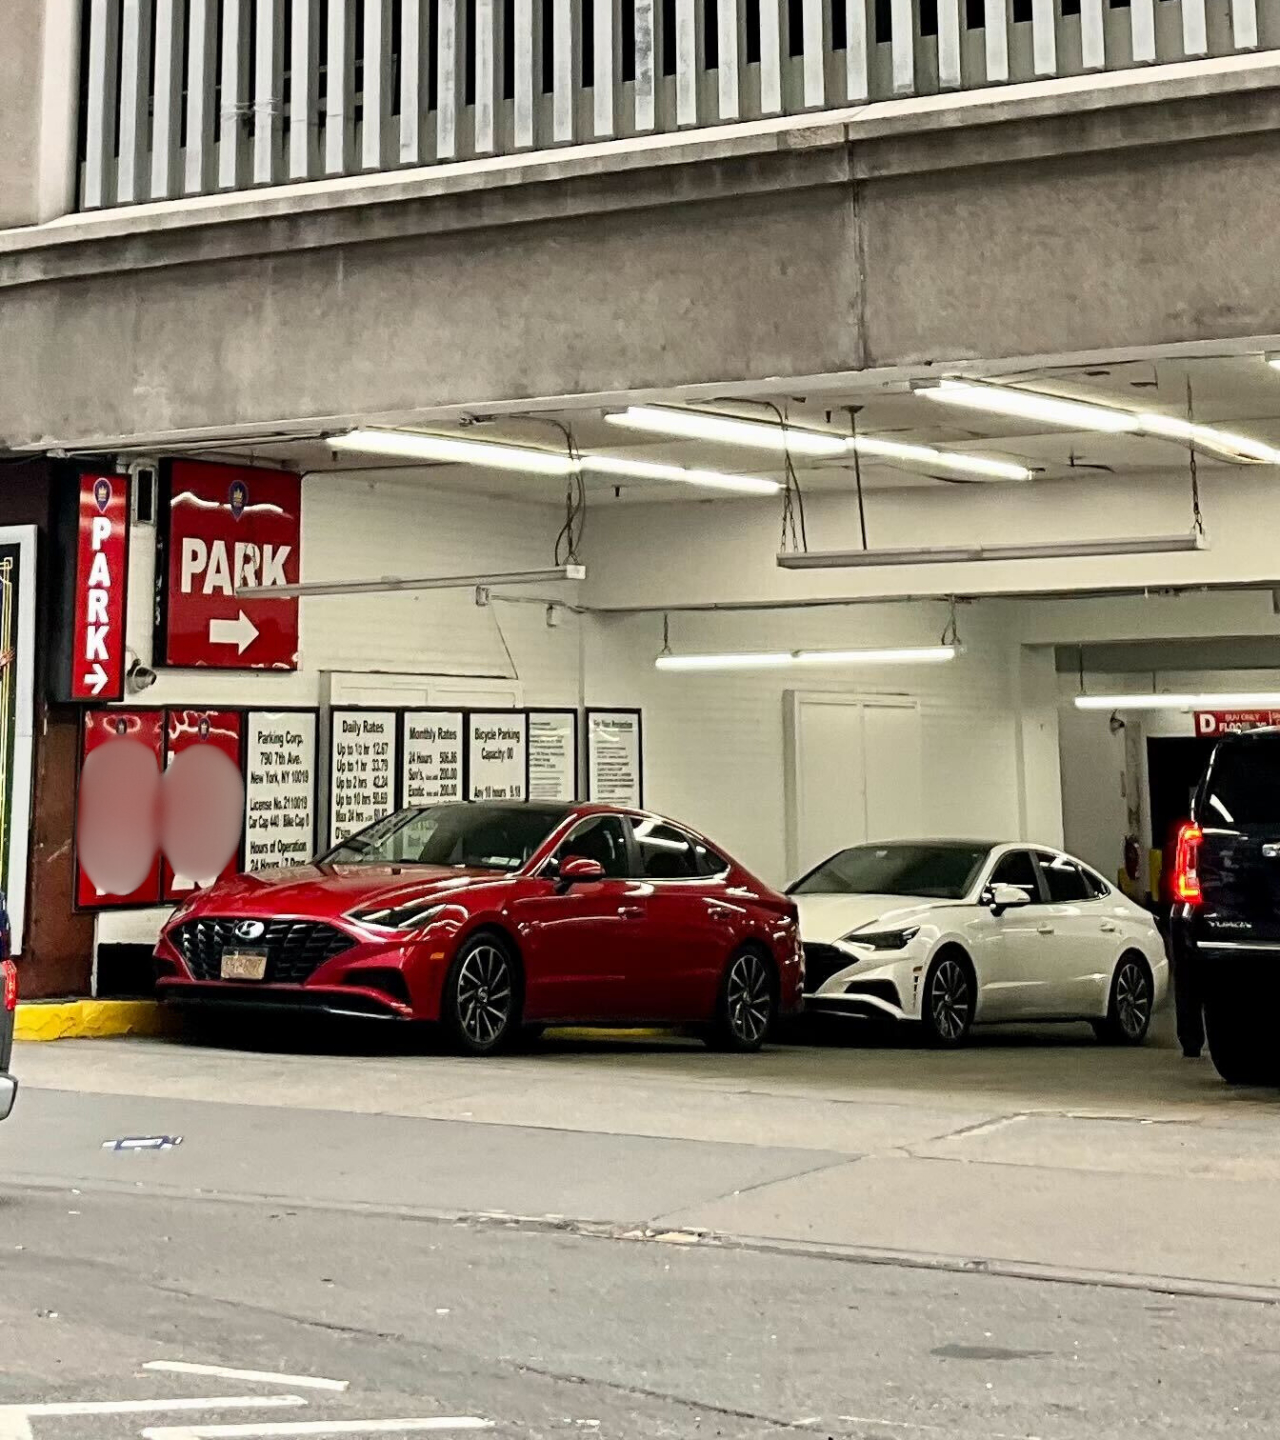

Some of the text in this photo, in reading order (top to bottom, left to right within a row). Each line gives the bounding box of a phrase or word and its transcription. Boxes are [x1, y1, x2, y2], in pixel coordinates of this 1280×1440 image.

[181, 537, 292, 599] PARK
[86, 516, 112, 661] PARK
[342, 720, 384, 736] Daily Rates
[1200, 713, 1216, 733] D
[258, 731, 284, 747] Parking
[409, 726, 457, 743] Monthly Rates
[475, 727, 520, 743] Bicycle Parking
[337, 742, 345, 758] Up
[337, 759, 345, 775] Up
[250, 771, 264, 784] New
[336, 776, 344, 792] Up
[250, 798, 272, 811] License
[335, 792, 344, 809] Up
[250, 841, 268, 854] Hours
[277, 839, 307, 855] Operation
